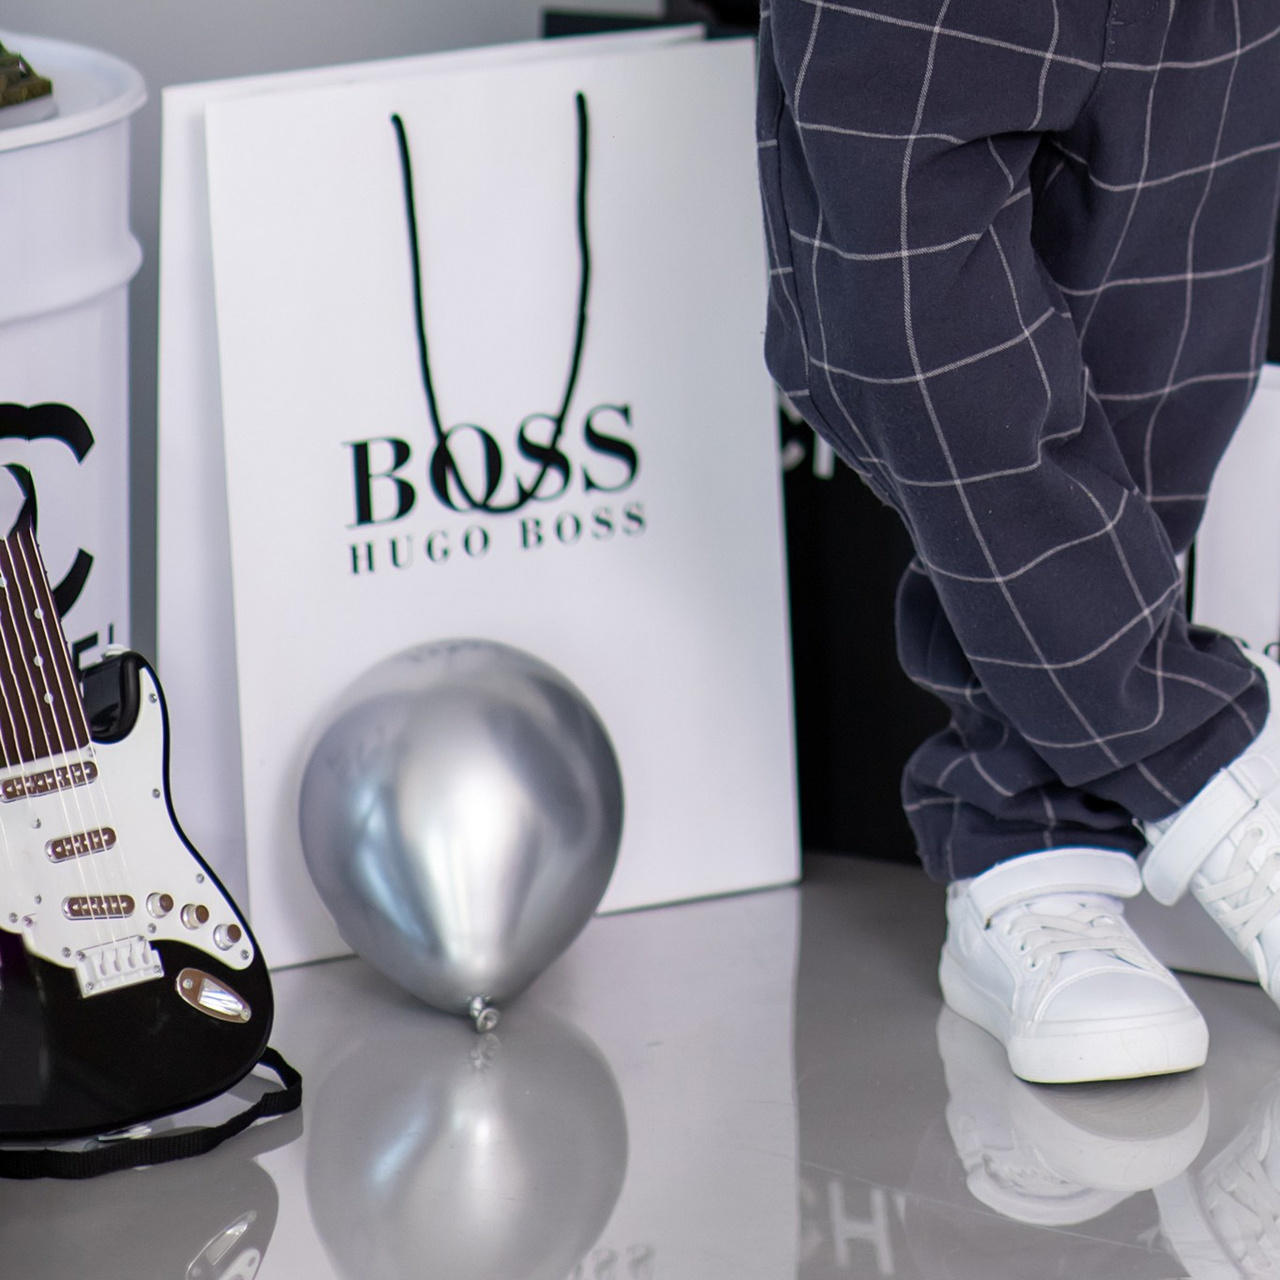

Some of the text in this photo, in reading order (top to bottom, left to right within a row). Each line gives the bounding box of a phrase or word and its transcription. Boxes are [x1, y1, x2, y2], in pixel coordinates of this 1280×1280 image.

[341, 403, 641, 529] BOSS
[349, 502, 647, 575] HUGO BOSS
